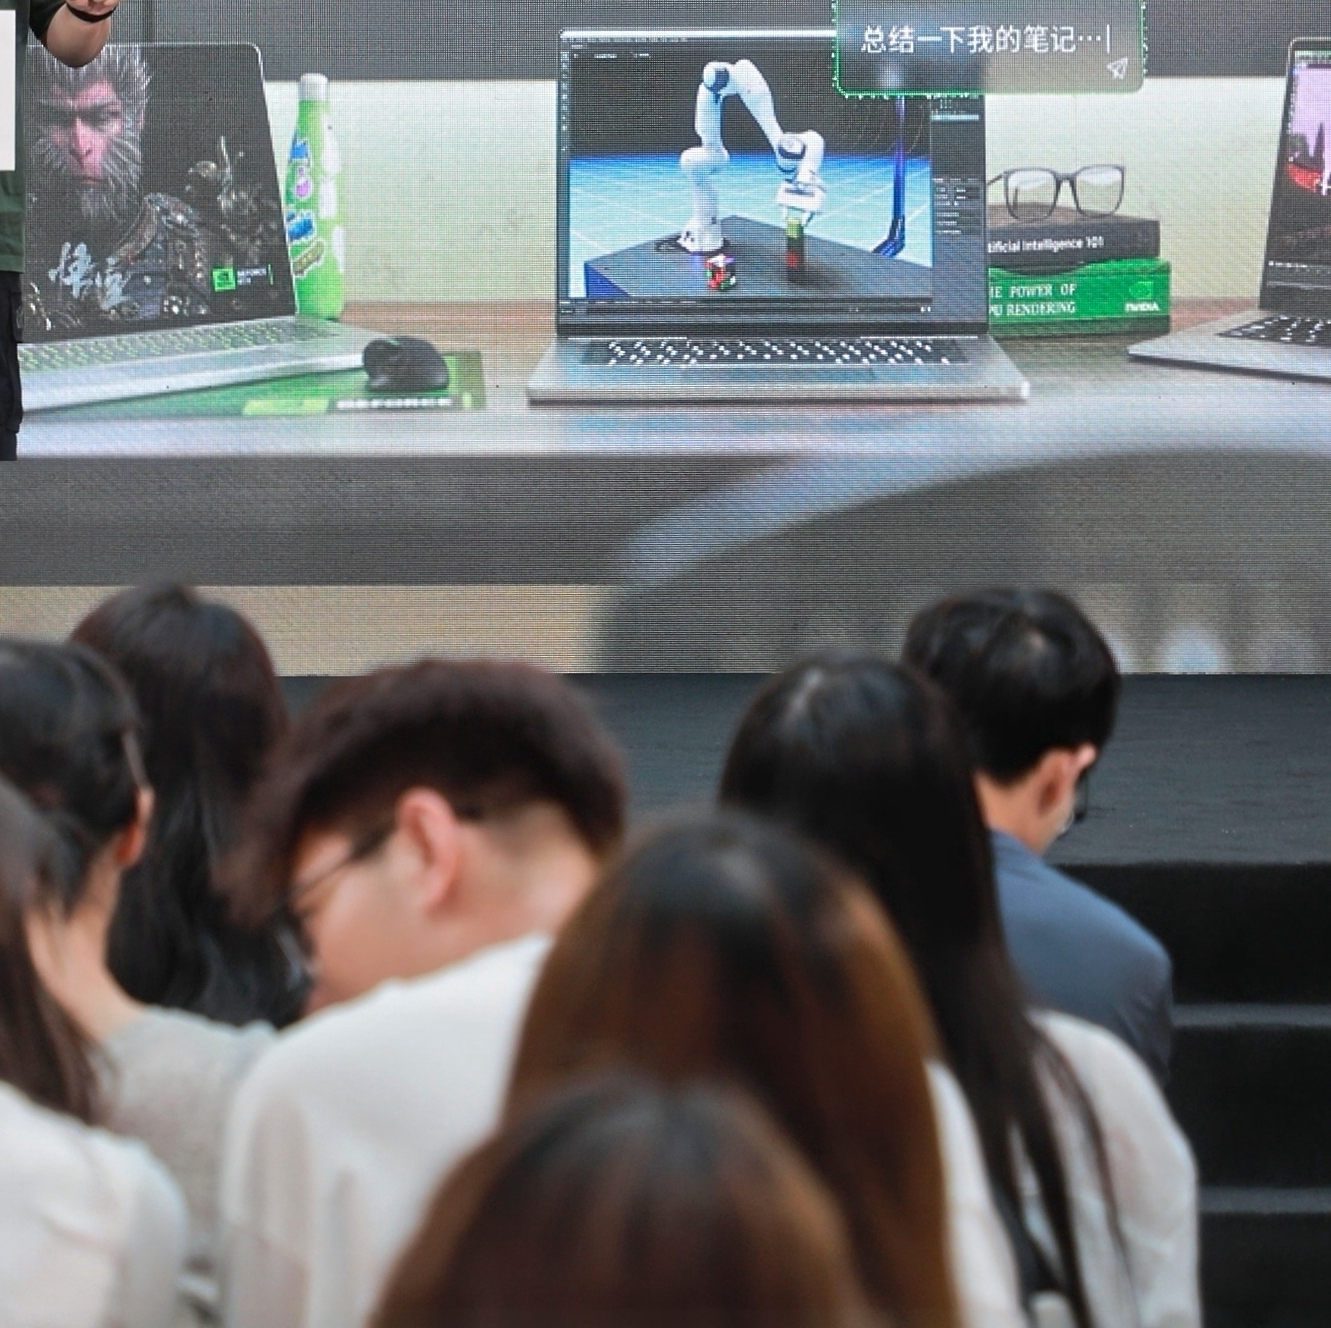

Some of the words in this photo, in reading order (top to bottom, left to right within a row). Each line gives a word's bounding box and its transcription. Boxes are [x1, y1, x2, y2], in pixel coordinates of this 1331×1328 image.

[1009, 284, 1052, 298] POWER
[1061, 283, 1077, 295] OF
[1007, 301, 1075, 316] RENDERING
